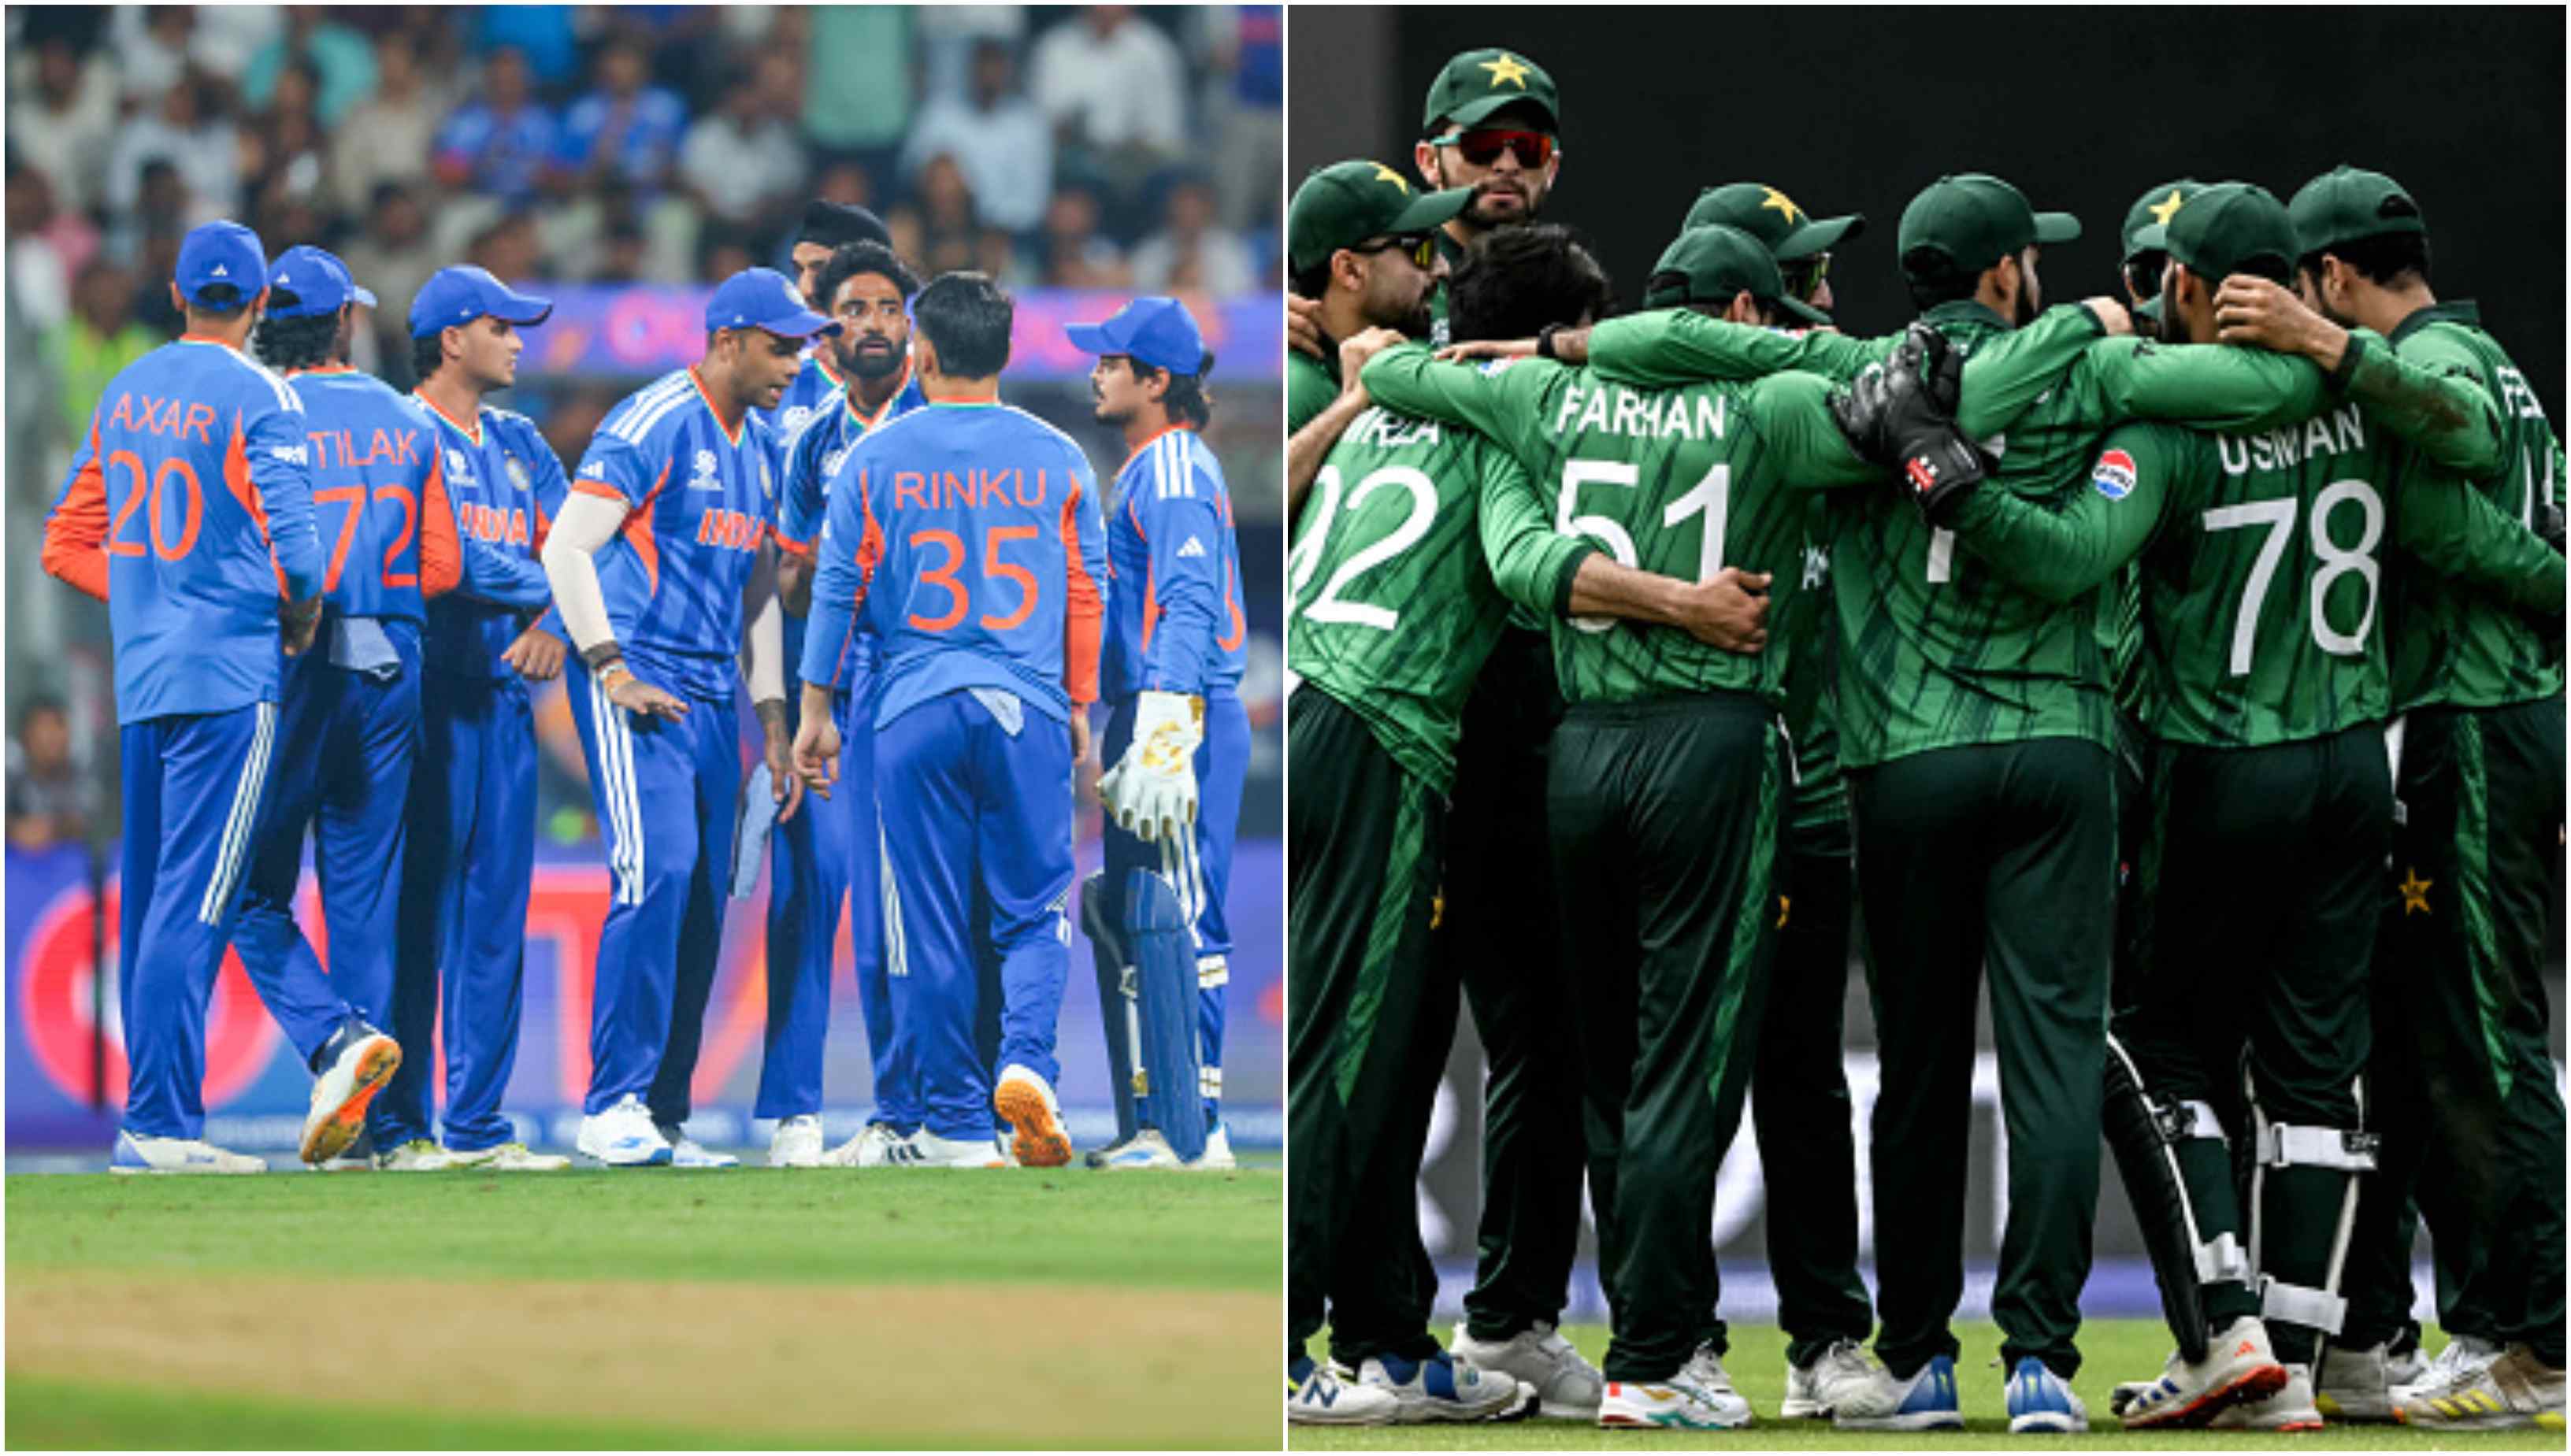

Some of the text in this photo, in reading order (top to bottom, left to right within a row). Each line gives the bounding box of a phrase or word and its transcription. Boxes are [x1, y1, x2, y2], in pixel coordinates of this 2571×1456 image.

[109, 391, 215, 446] AXAR
[306, 428, 420, 469] TILAK
[1556, 384, 1725, 440] FARHAN
[2217, 402, 2365, 475] USMAN
[109, 450, 204, 561] 20
[895, 467, 1046, 509] RINKU
[313, 483, 417, 593] 72
[908, 524, 1039, 632] 35
[1556, 458, 1730, 634] 51
[2202, 478, 2385, 676] 78
